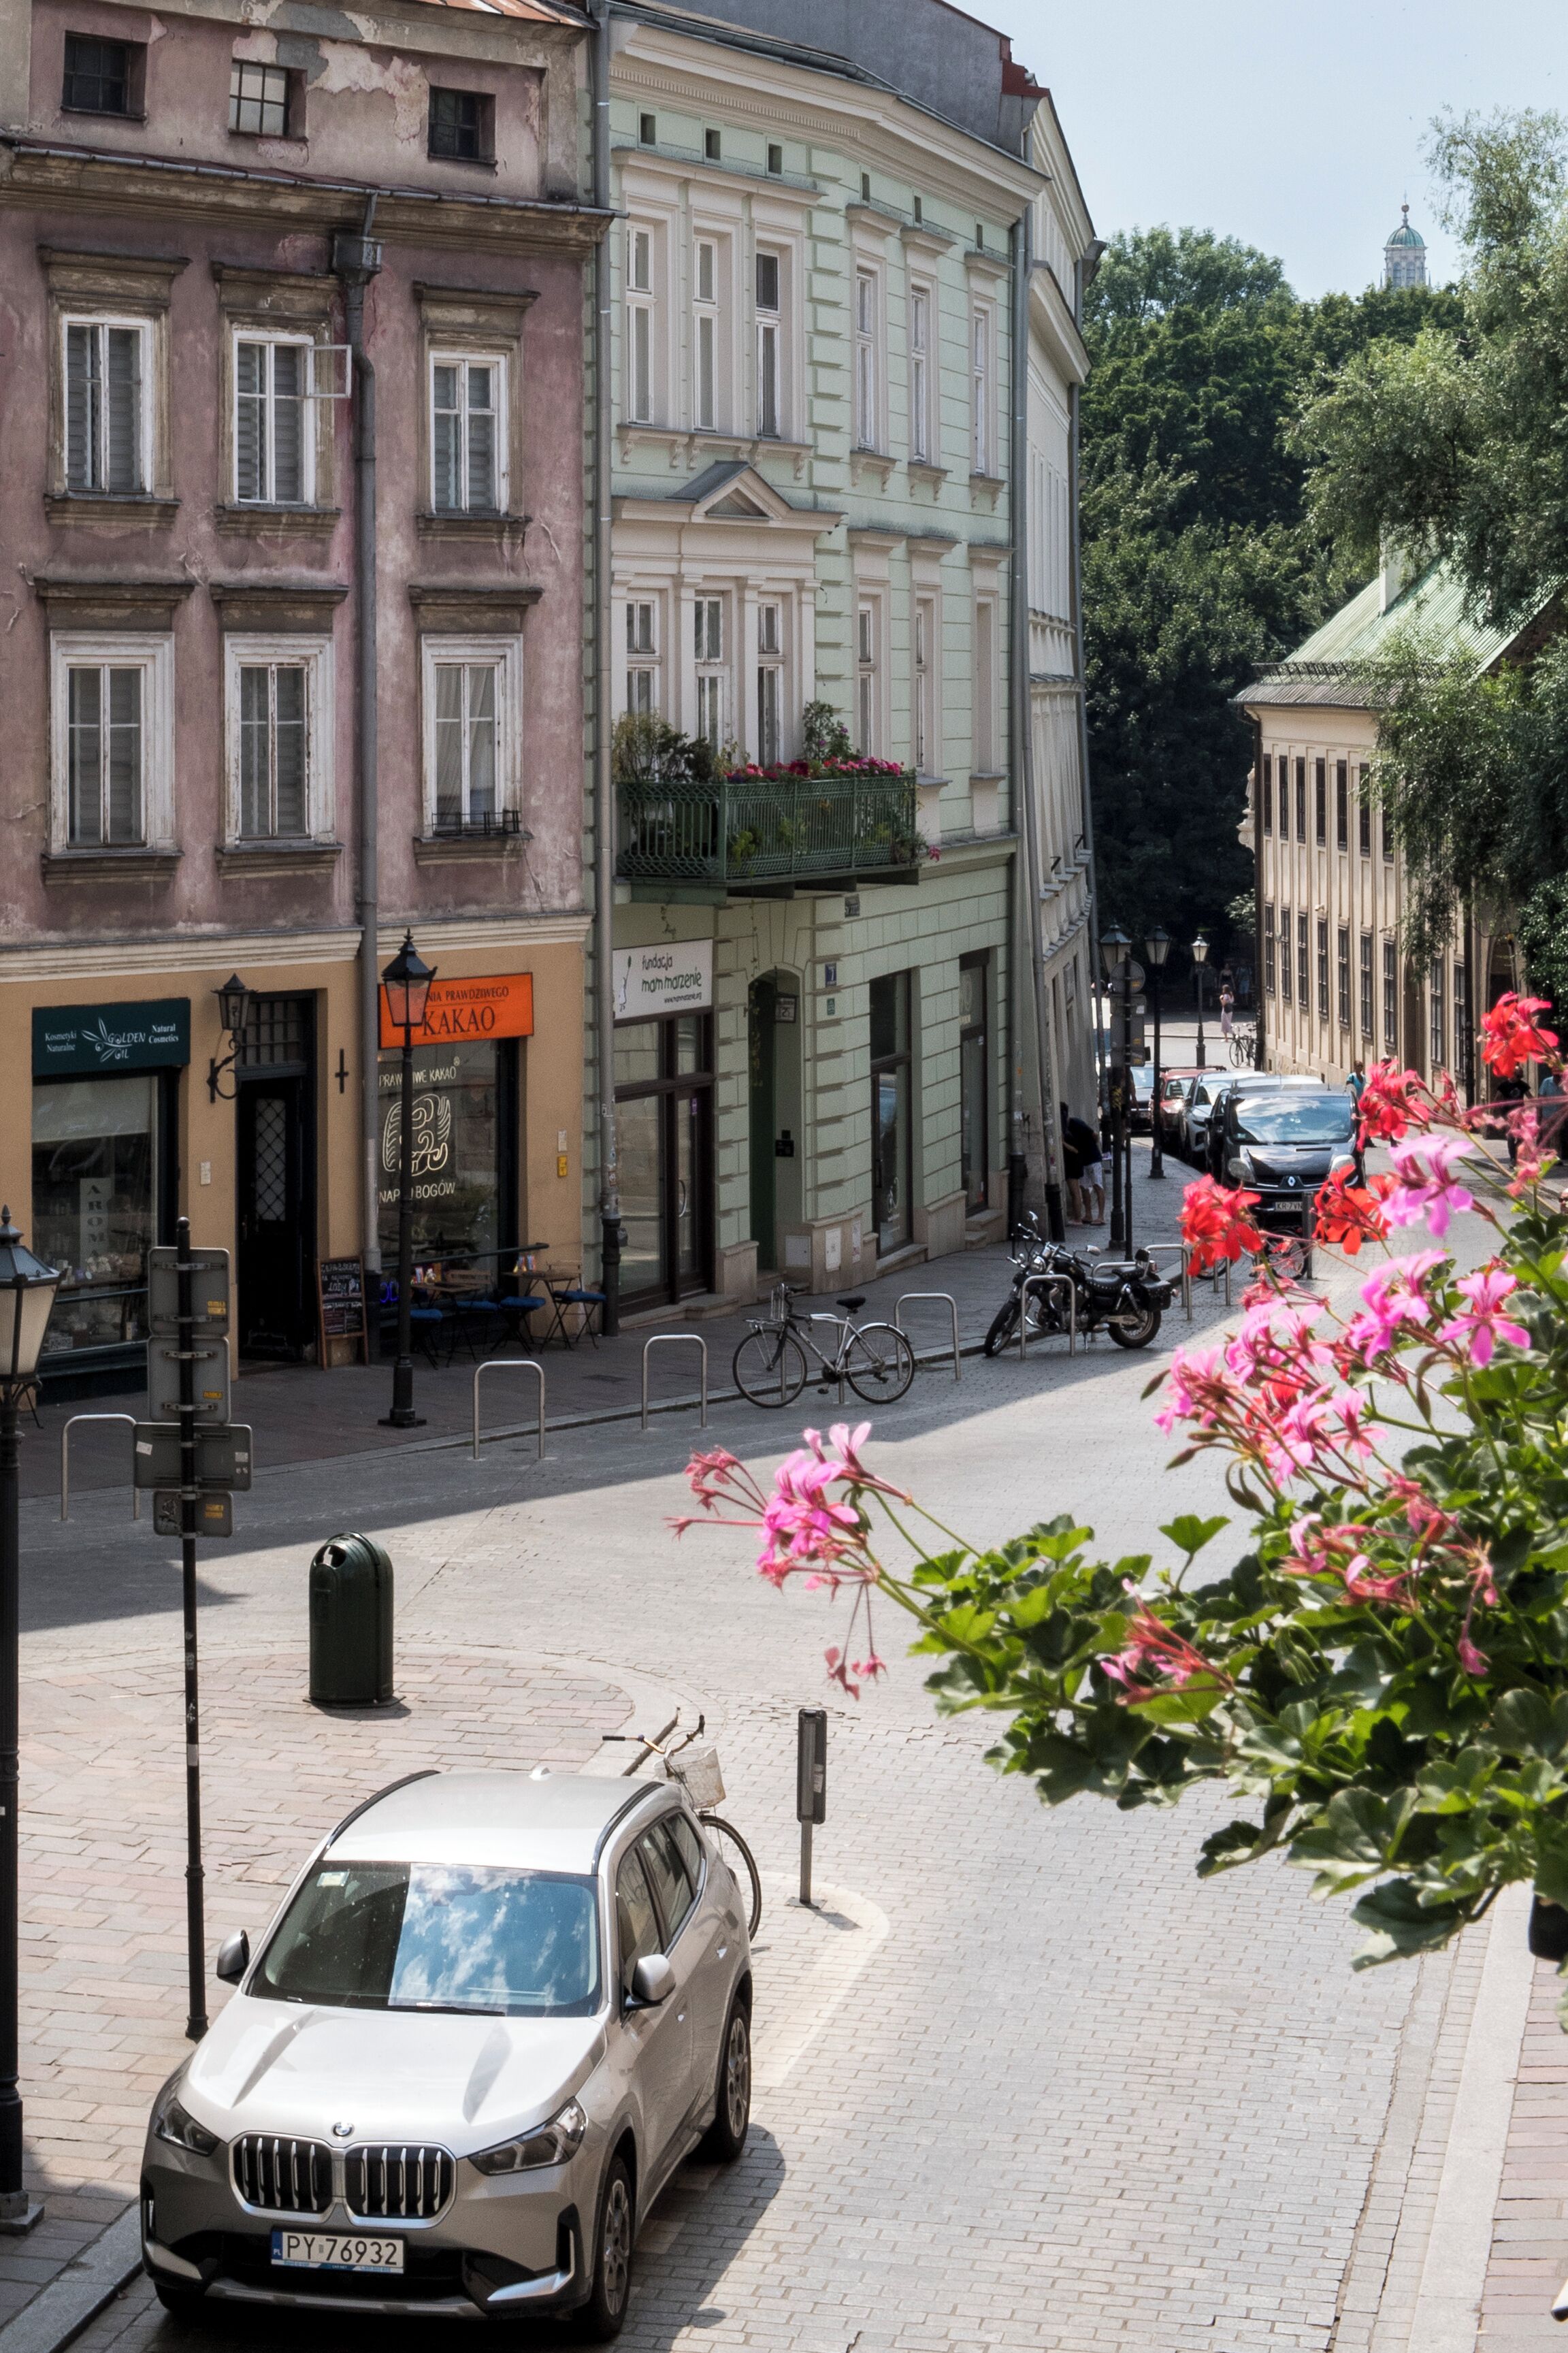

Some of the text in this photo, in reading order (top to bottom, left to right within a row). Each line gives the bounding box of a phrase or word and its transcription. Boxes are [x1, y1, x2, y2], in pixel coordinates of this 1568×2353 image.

[642, 953, 673, 971] fundacja
[642, 967, 702, 993] mam marzenie
[446, 987, 509, 1001] PRAWDZIWEGO
[152, 1023, 176, 1034] Natural
[423, 1006, 495, 1036] KAKAO
[45, 1031, 77, 1042] Kosmetyki
[108, 1032, 146, 1044] GOLDEN
[148, 1034, 179, 1045] Cosmetics
[46, 1042, 76, 1053] Naturalne
[379, 1066, 457, 1088] PRAWIWE KAKAO
[379, 1180, 455, 1204] NAPJ BOGÓW
[287, 2235, 397, 2266] PY 76932
